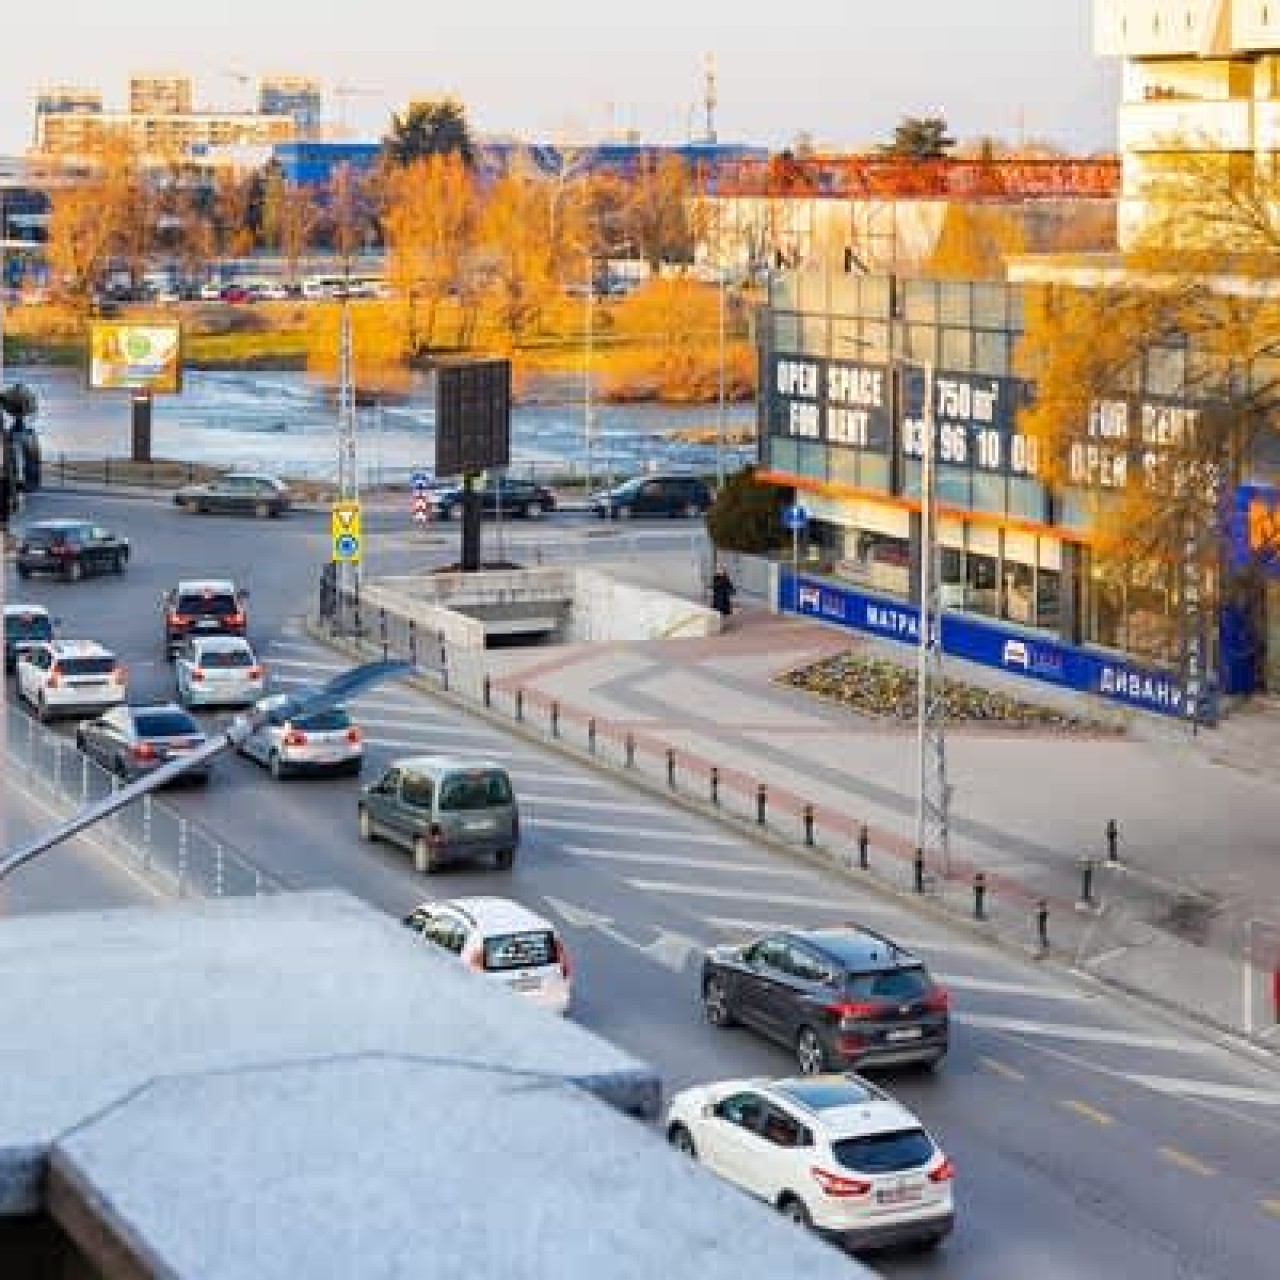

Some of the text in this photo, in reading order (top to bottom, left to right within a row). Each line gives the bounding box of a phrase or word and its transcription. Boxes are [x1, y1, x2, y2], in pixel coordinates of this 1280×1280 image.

[777, 361, 883, 408] OPEN SPACE
[938, 381, 970, 419] 750
[790, 400, 868, 447] FOR RENT
[1087, 399, 1127, 438] FOR
[904, 419, 933, 457] 03
[940, 422, 967, 463] 96
[976, 429, 1000, 469] 10
[867, 606, 937, 643] МАТРА
